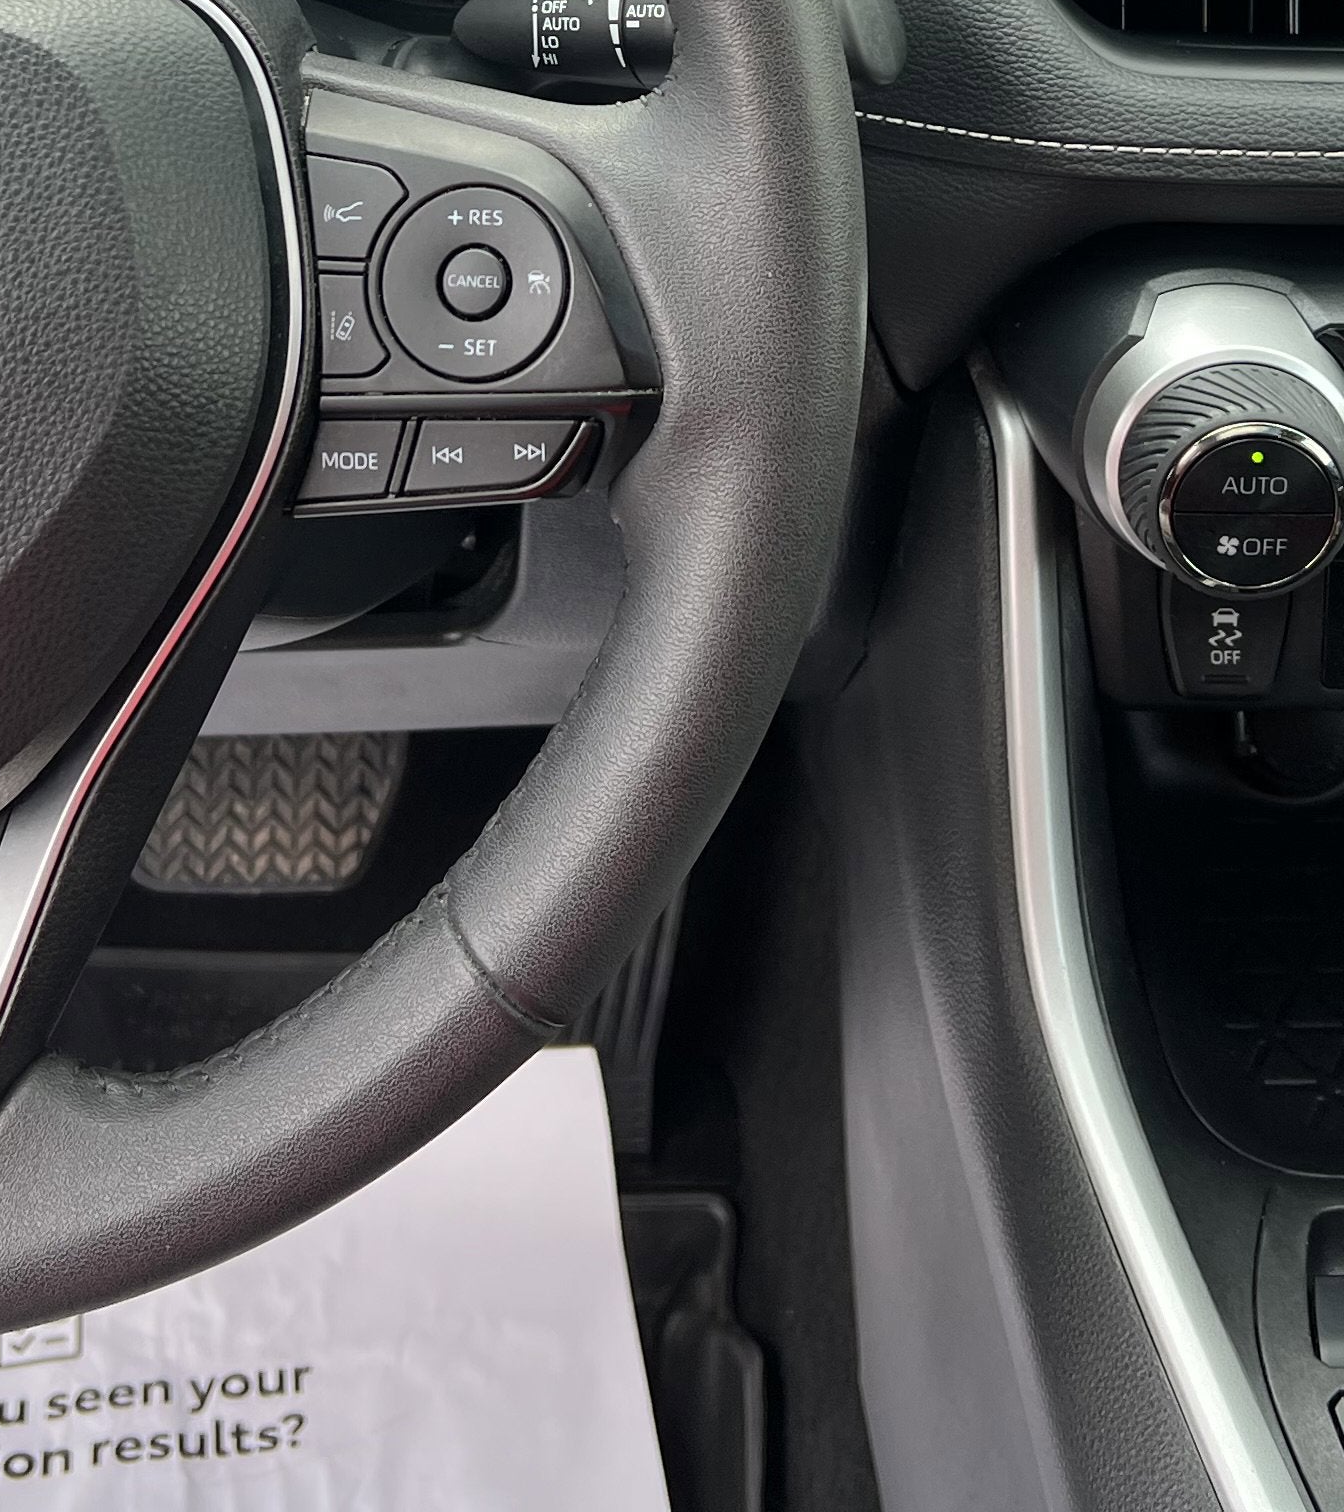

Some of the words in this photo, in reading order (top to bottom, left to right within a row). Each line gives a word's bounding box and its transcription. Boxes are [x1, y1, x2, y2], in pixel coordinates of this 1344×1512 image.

[542, 0, 567, 13] OFF
[625, 4, 665, 17] AUTO
[543, 17, 580, 31] AUTO
[542, 36, 559, 48] LO
[543, 53, 558, 64] HI
[469, 210, 502, 225] RES
[447, 273, 500, 288] CANCEL
[464, 339, 497, 355] SET
[322, 452, 378, 470] MODE
[1222, 477, 1287, 494] AUTO
[1243, 538, 1287, 555] OFF
[1211, 650, 1240, 664] OFF
[48, 1380, 171, 1419] seen
[190, 1364, 311, 1412] your
[93, 1414, 304, 1465] results?
